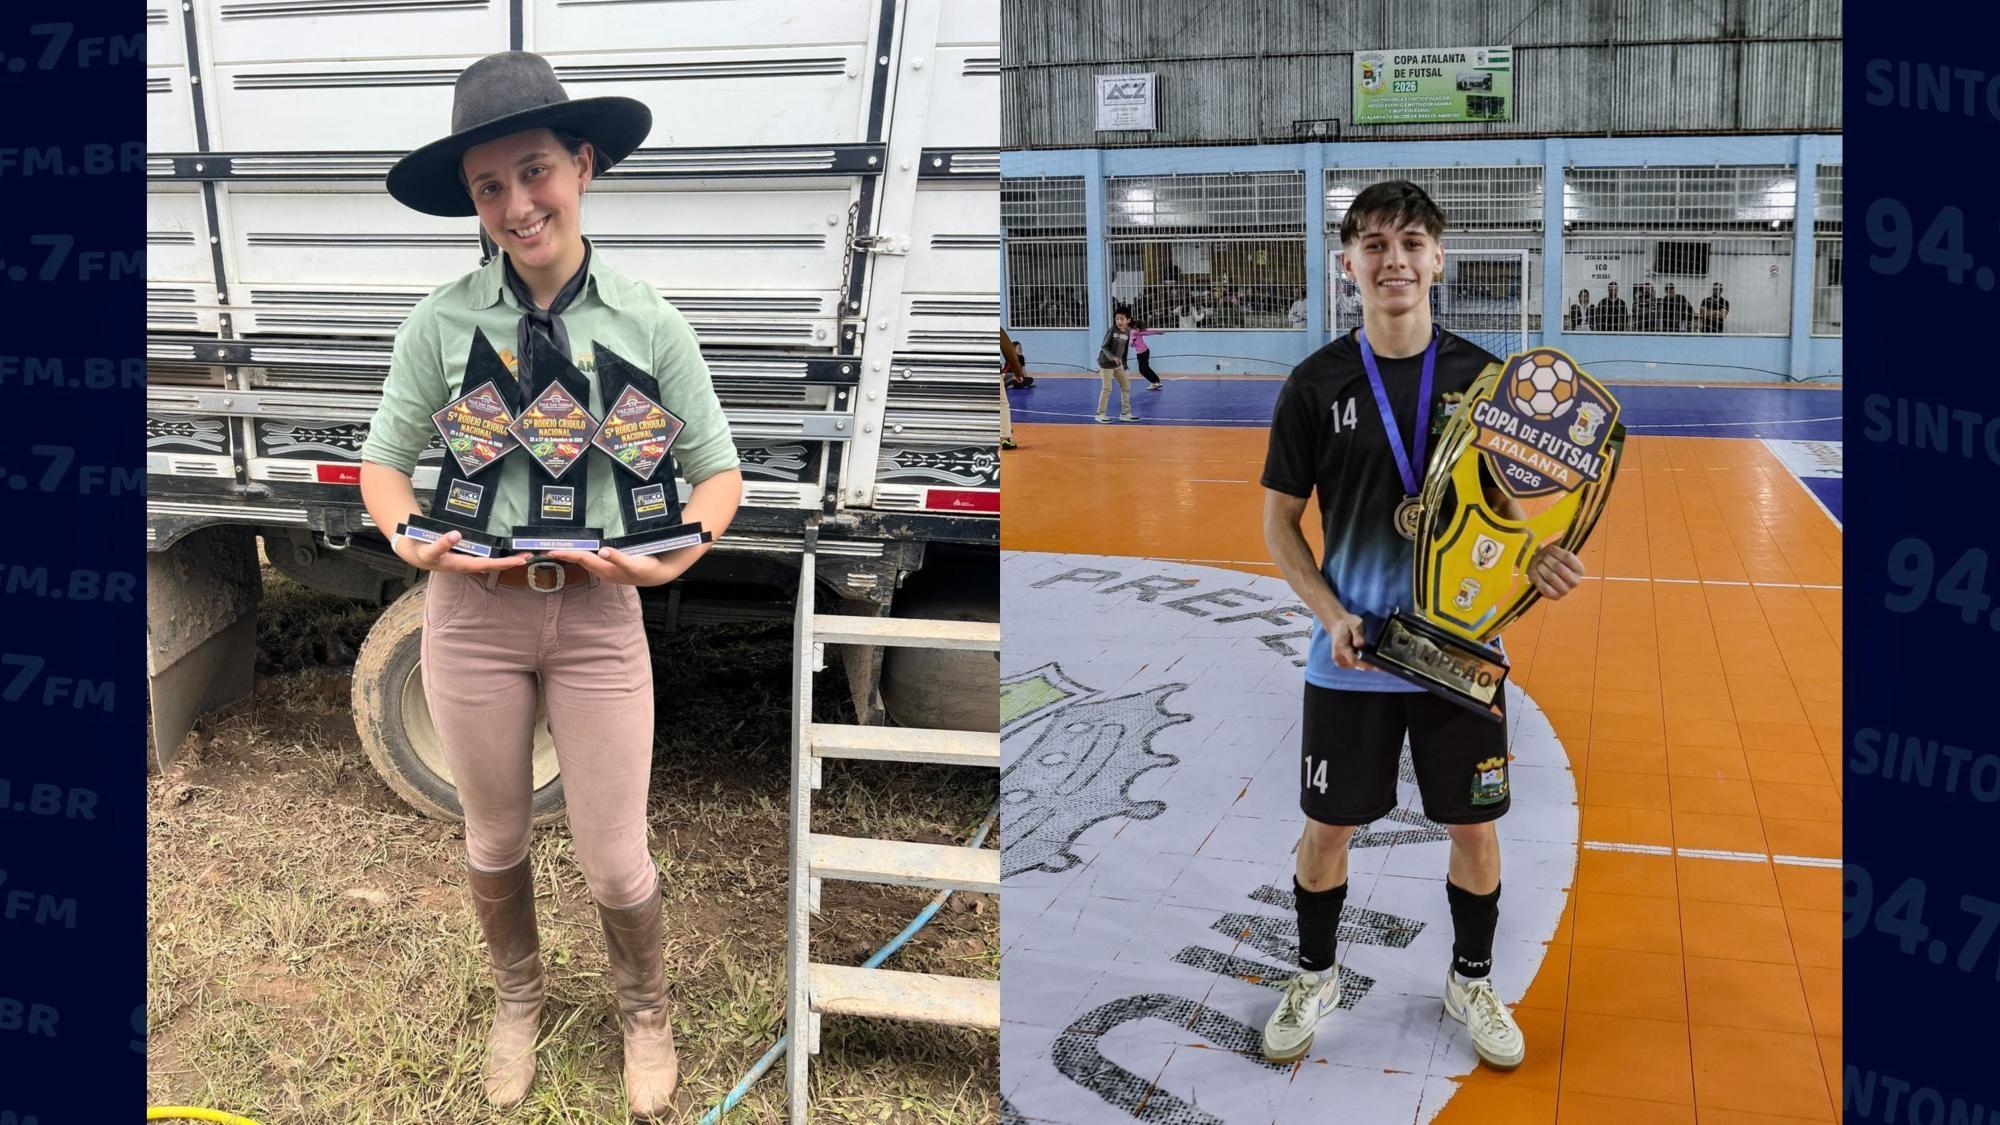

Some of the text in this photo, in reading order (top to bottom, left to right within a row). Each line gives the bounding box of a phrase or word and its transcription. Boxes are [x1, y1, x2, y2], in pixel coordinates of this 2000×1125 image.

[1394, 53, 1466, 65] COPA ATALANTA
[1394, 67, 1443, 78] DE FUTSAL
[1106, 82, 1146, 100] ACZ
[1394, 81, 1417, 93] 2026
[457, 415, 482, 426] RODEIO
[1330, 397, 1358, 434] 14
[461, 425, 492, 438] NACIONAL
[534, 419, 557, 428] RODEIO
[558, 419, 586, 431] CRIOULO
[615, 422, 637, 435] RODEIO
[638, 419, 666, 430] CRIOULO
[538, 428, 571, 437] NACIONAL
[621, 430, 653, 442] NACIONAL
[1473, 400, 1604, 479] COPA DE FUTSAL
[1488, 435, 1569, 482] ATALANTA
[1506, 463, 1542, 488] 2026
[1391, 633, 1492, 688] CAMPEÃO
[1304, 755, 1329, 795] 14
